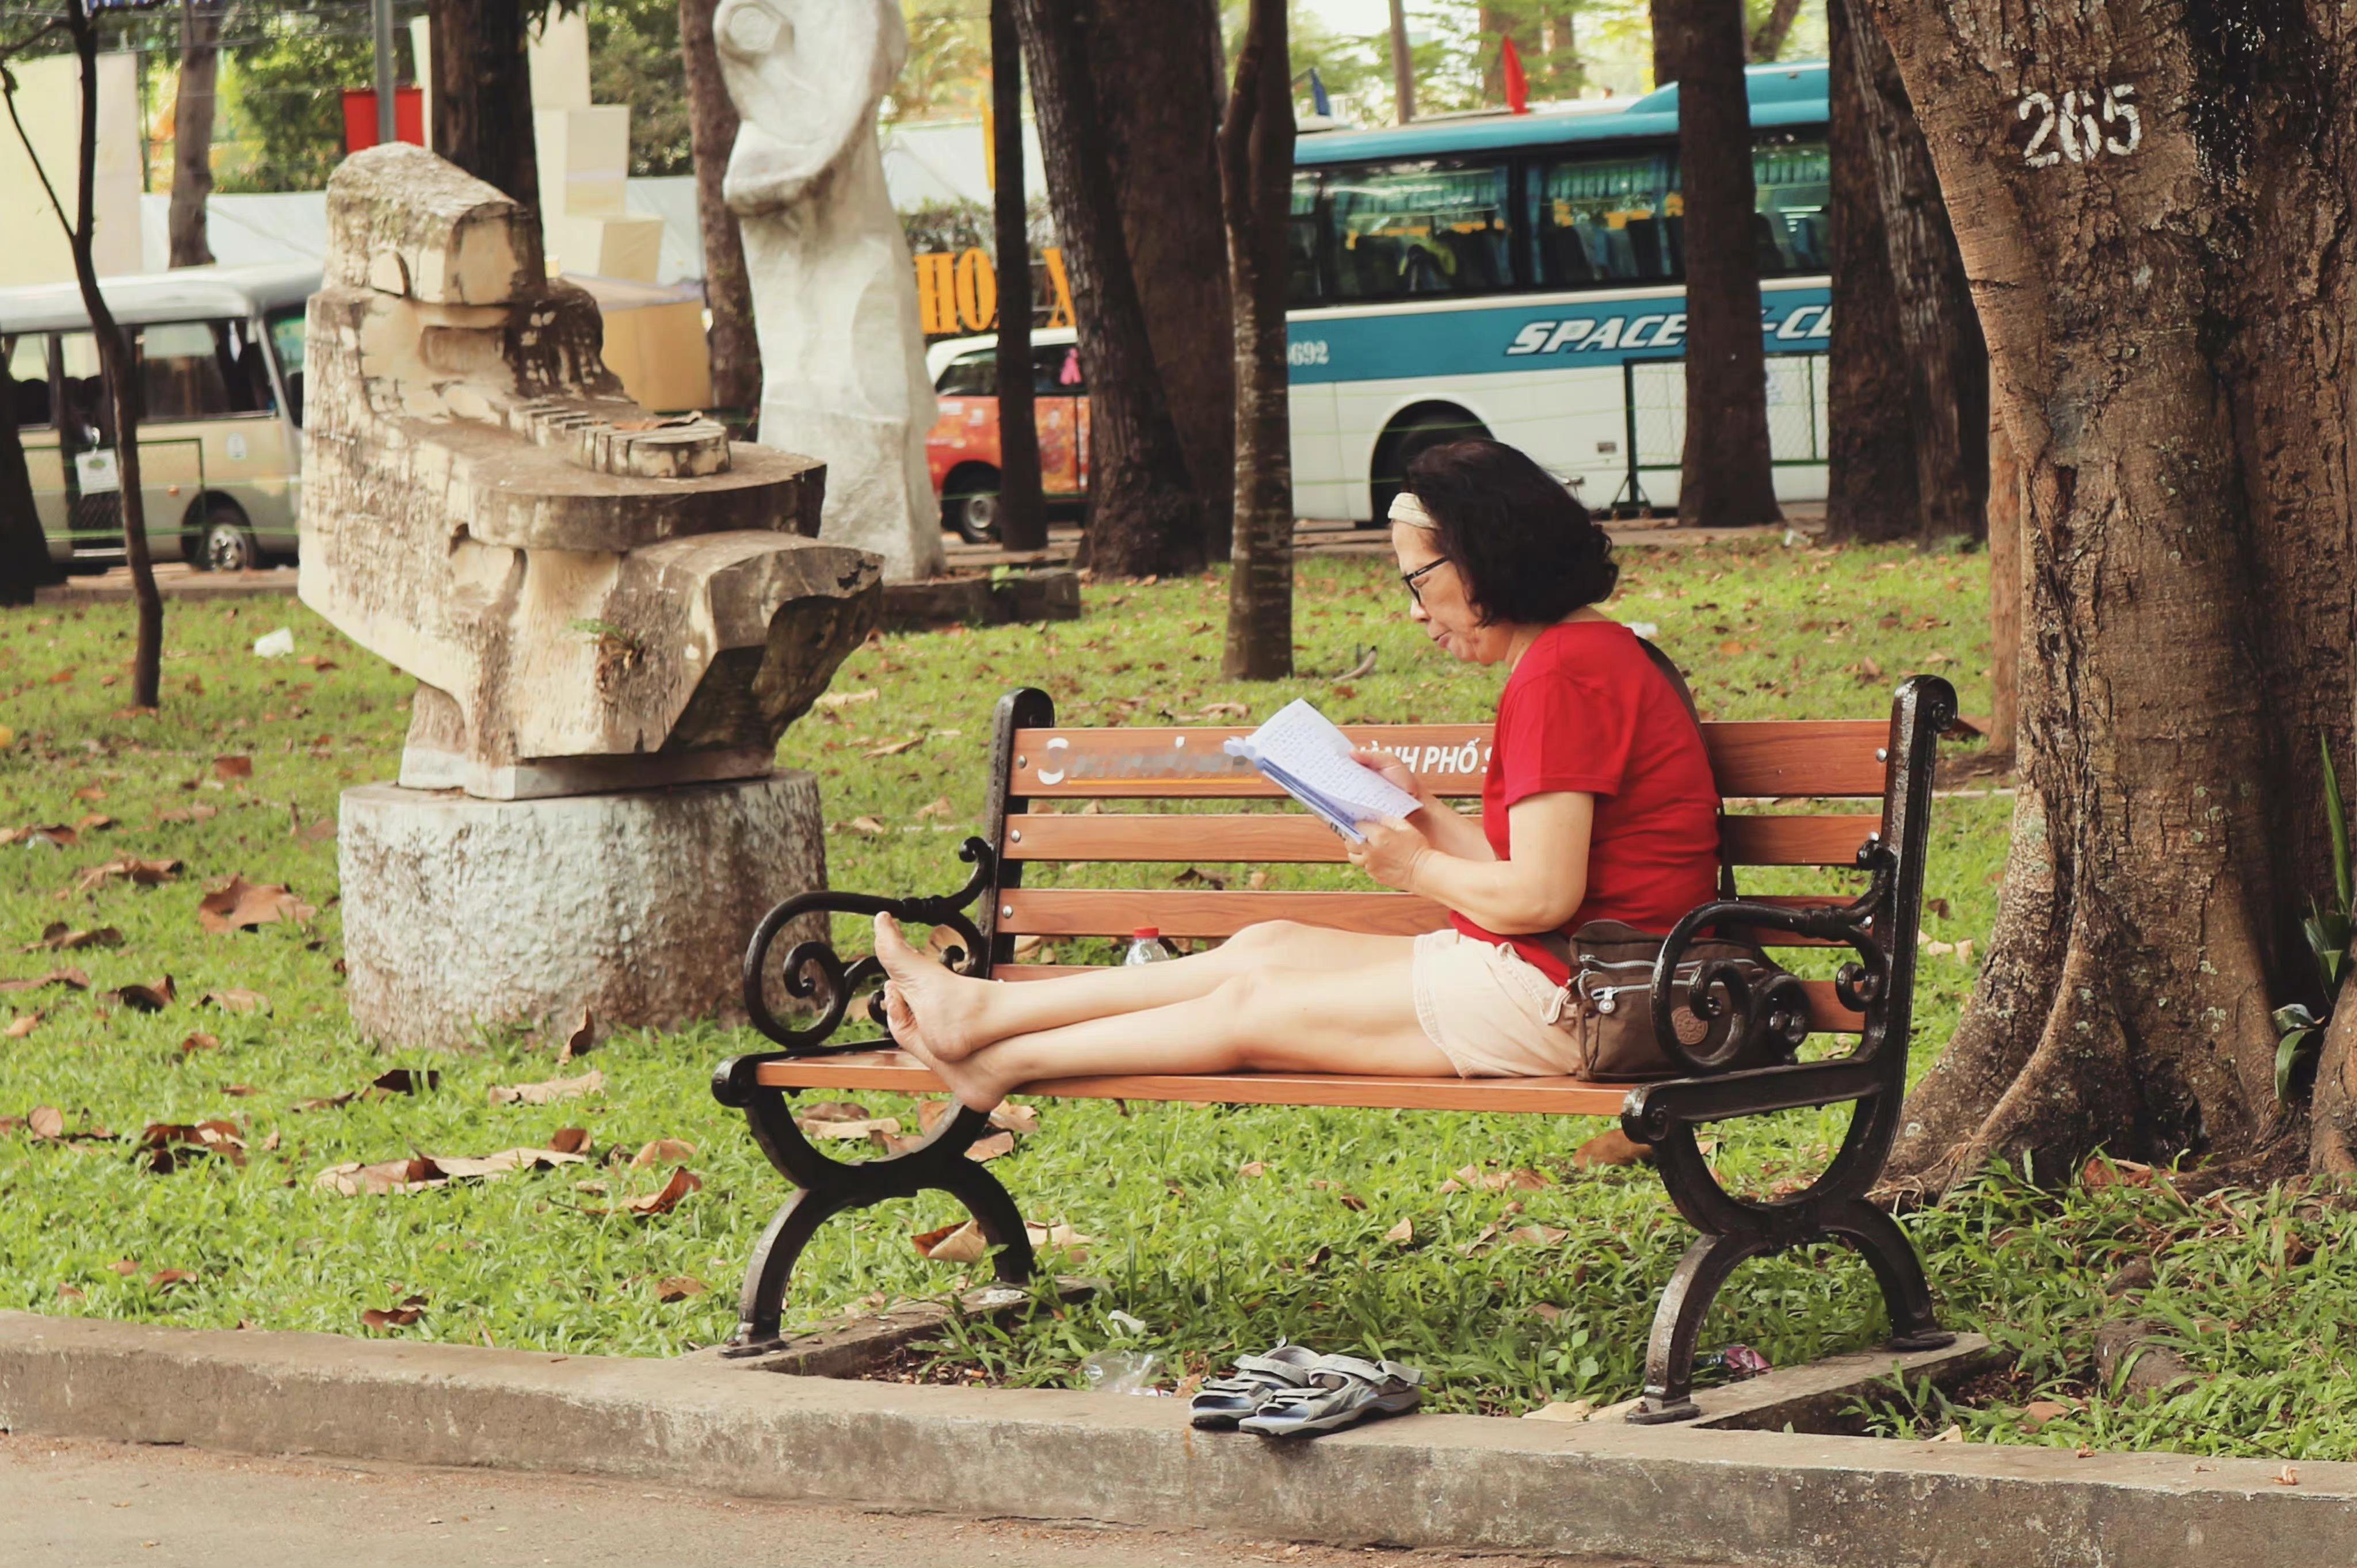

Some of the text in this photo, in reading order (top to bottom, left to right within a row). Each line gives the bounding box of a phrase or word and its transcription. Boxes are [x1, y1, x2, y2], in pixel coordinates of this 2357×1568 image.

[2018, 83, 2141, 168] 265
[913, 246, 999, 334] HO
[1287, 340, 1329, 365] 692
[1505, 314, 1688, 355] SPACE
[1421, 737, 1481, 773] PHỐ
